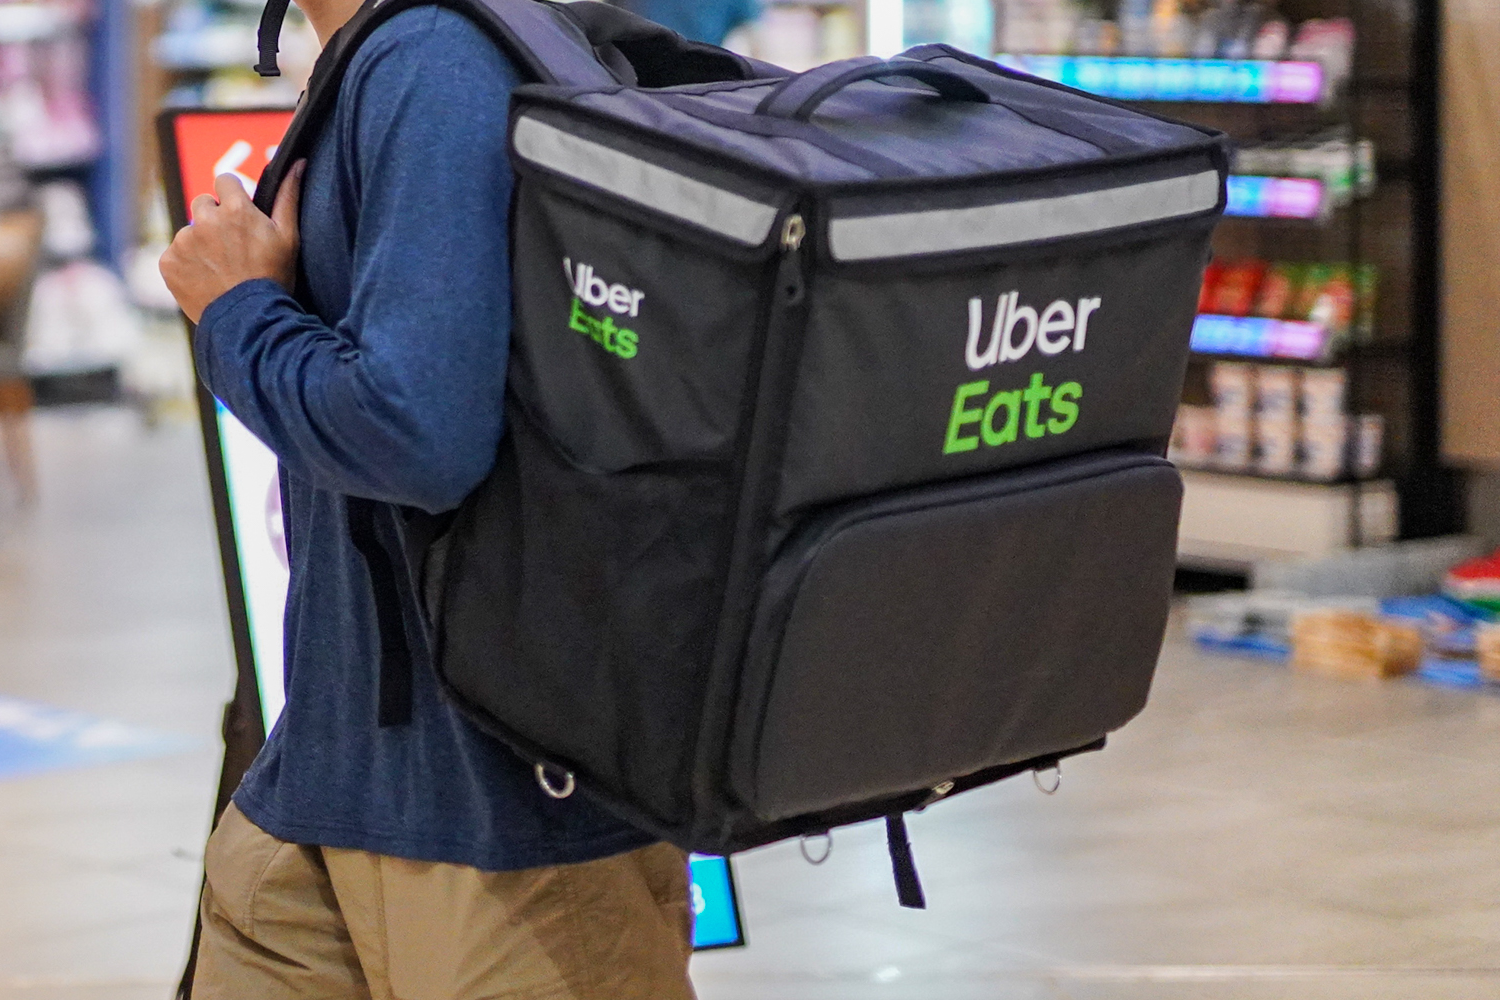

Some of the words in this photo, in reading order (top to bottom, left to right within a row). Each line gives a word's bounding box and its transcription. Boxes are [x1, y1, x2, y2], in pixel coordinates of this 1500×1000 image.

[563, 257, 645, 317] Uber
[965, 290, 1101, 370] Uber
[943, 372, 1083, 454] Eats
